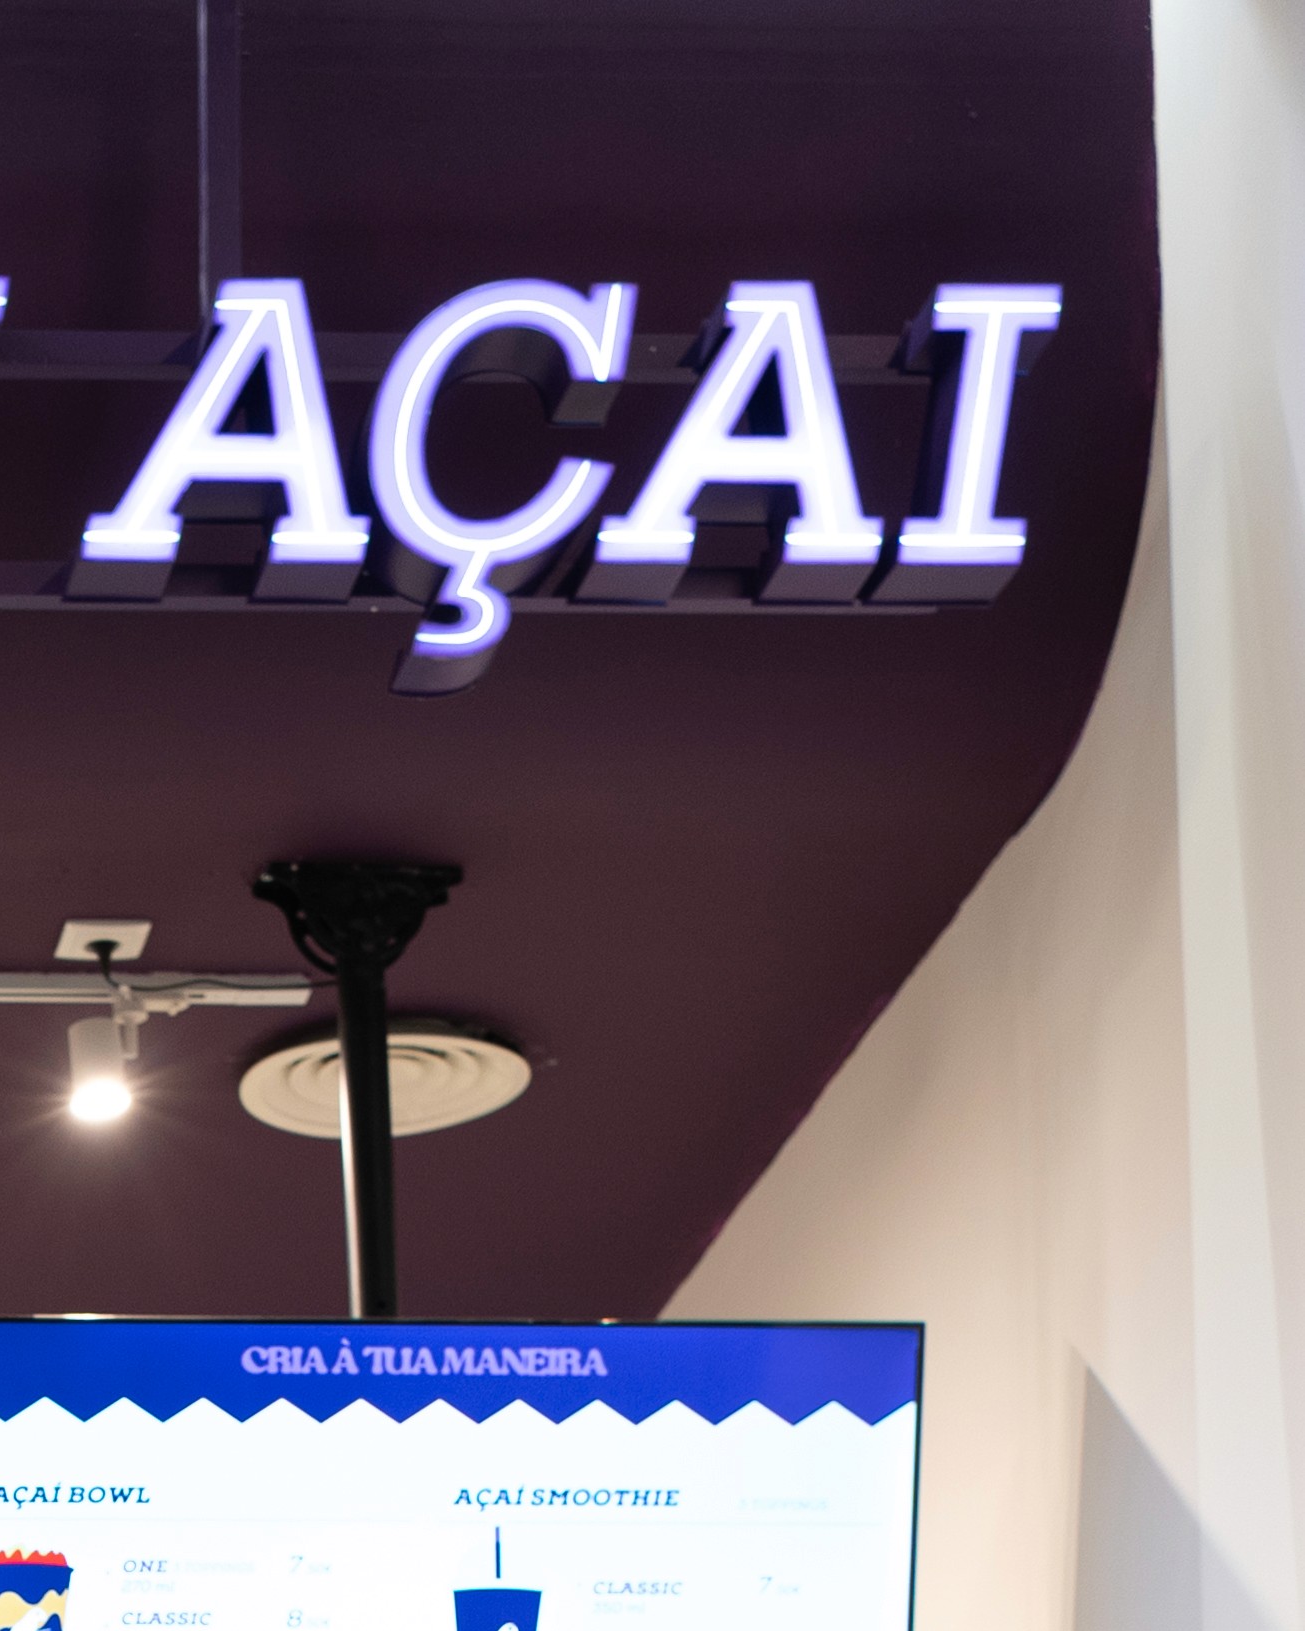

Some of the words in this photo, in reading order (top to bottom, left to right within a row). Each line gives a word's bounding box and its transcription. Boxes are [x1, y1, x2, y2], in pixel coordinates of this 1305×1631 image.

[81, 279, 1065, 652] AÇAI
[241, 1346, 327, 1375] CRIA
[331, 1338, 359, 1376] À
[362, 1346, 438, 1376] TUA
[441, 1347, 608, 1377] MANEIRA
[68, 1486, 151, 1503] BOWL
[454, 1484, 525, 1512] AÇAÍ
[531, 1488, 680, 1507] SMOOTHIE
[122, 1558, 168, 1573] ONE
[592, 1580, 685, 1596] CLASSIC
[121, 1611, 213, 1627] CLASSIC
